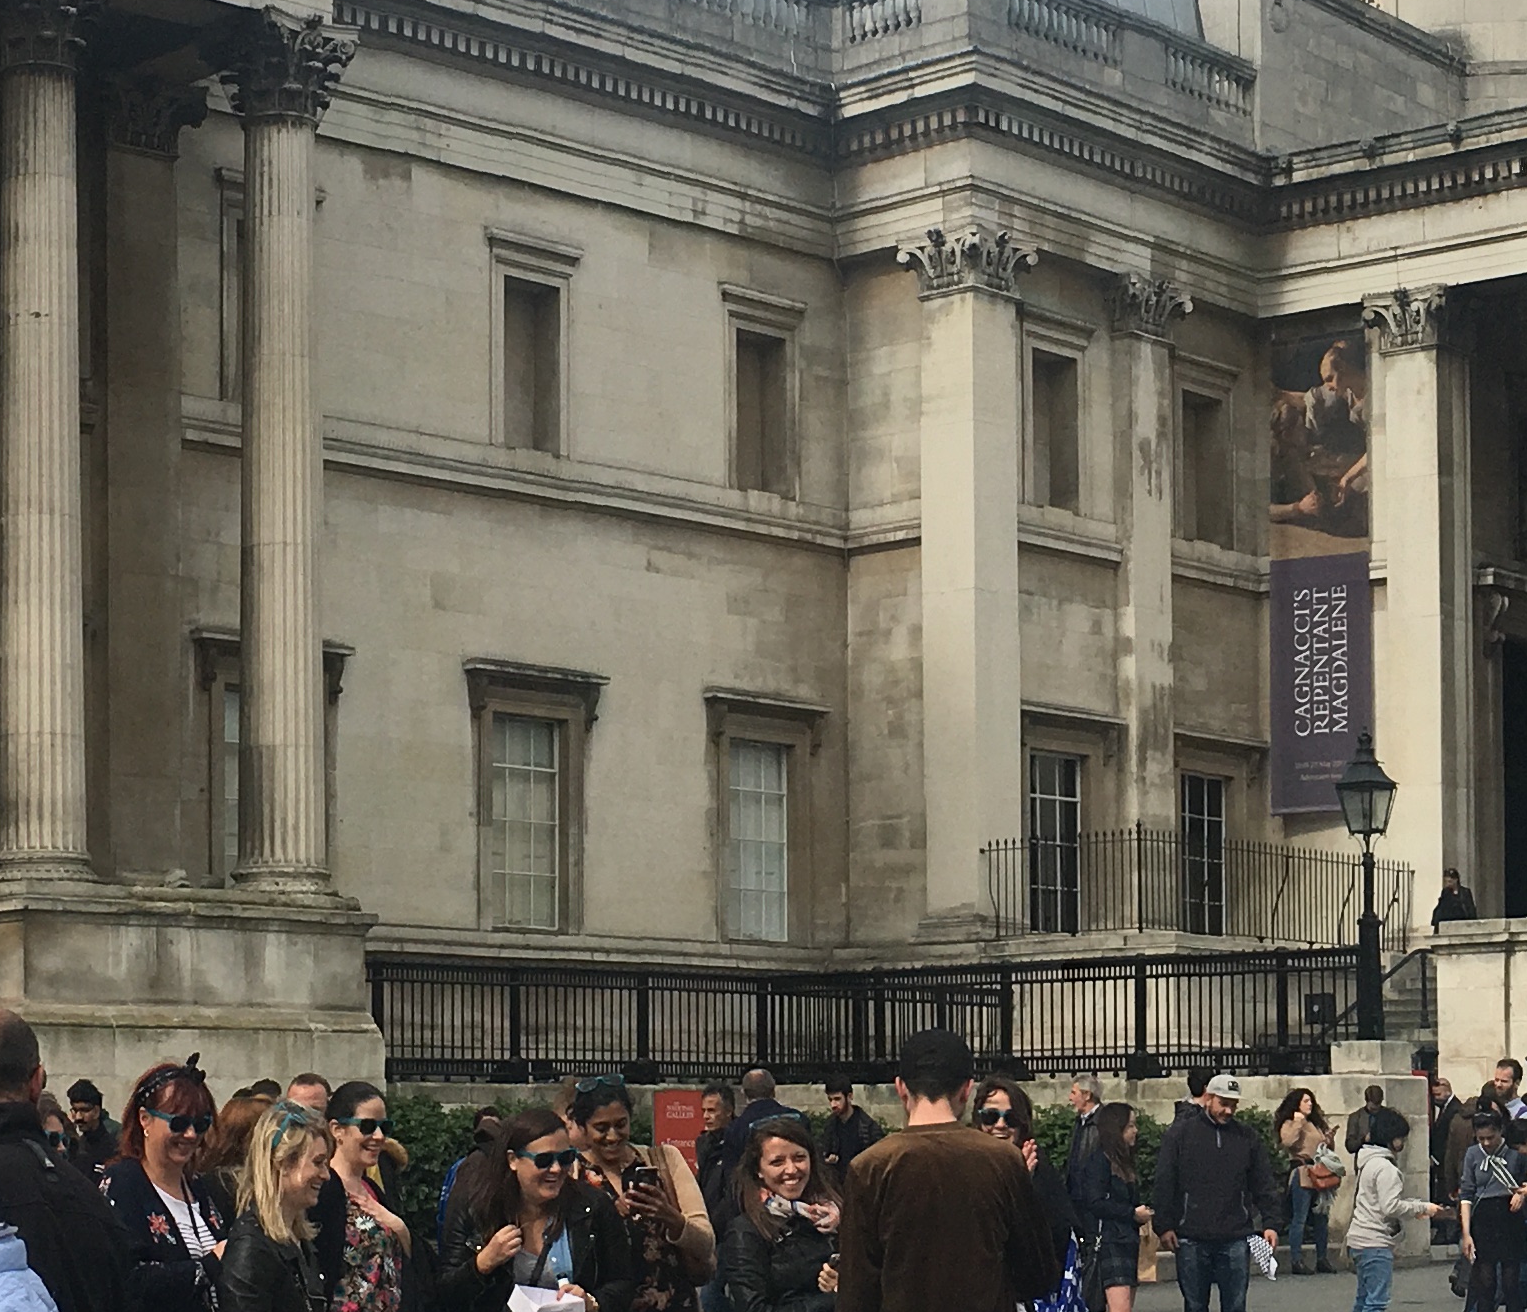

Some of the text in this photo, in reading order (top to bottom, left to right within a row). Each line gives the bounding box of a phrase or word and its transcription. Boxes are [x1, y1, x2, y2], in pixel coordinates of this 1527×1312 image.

[1294, 588, 1311, 737] CAGNACCI'S
[1313, 586, 1330, 735] REPENTANT
[1331, 583, 1348, 733] MAGDALENE
